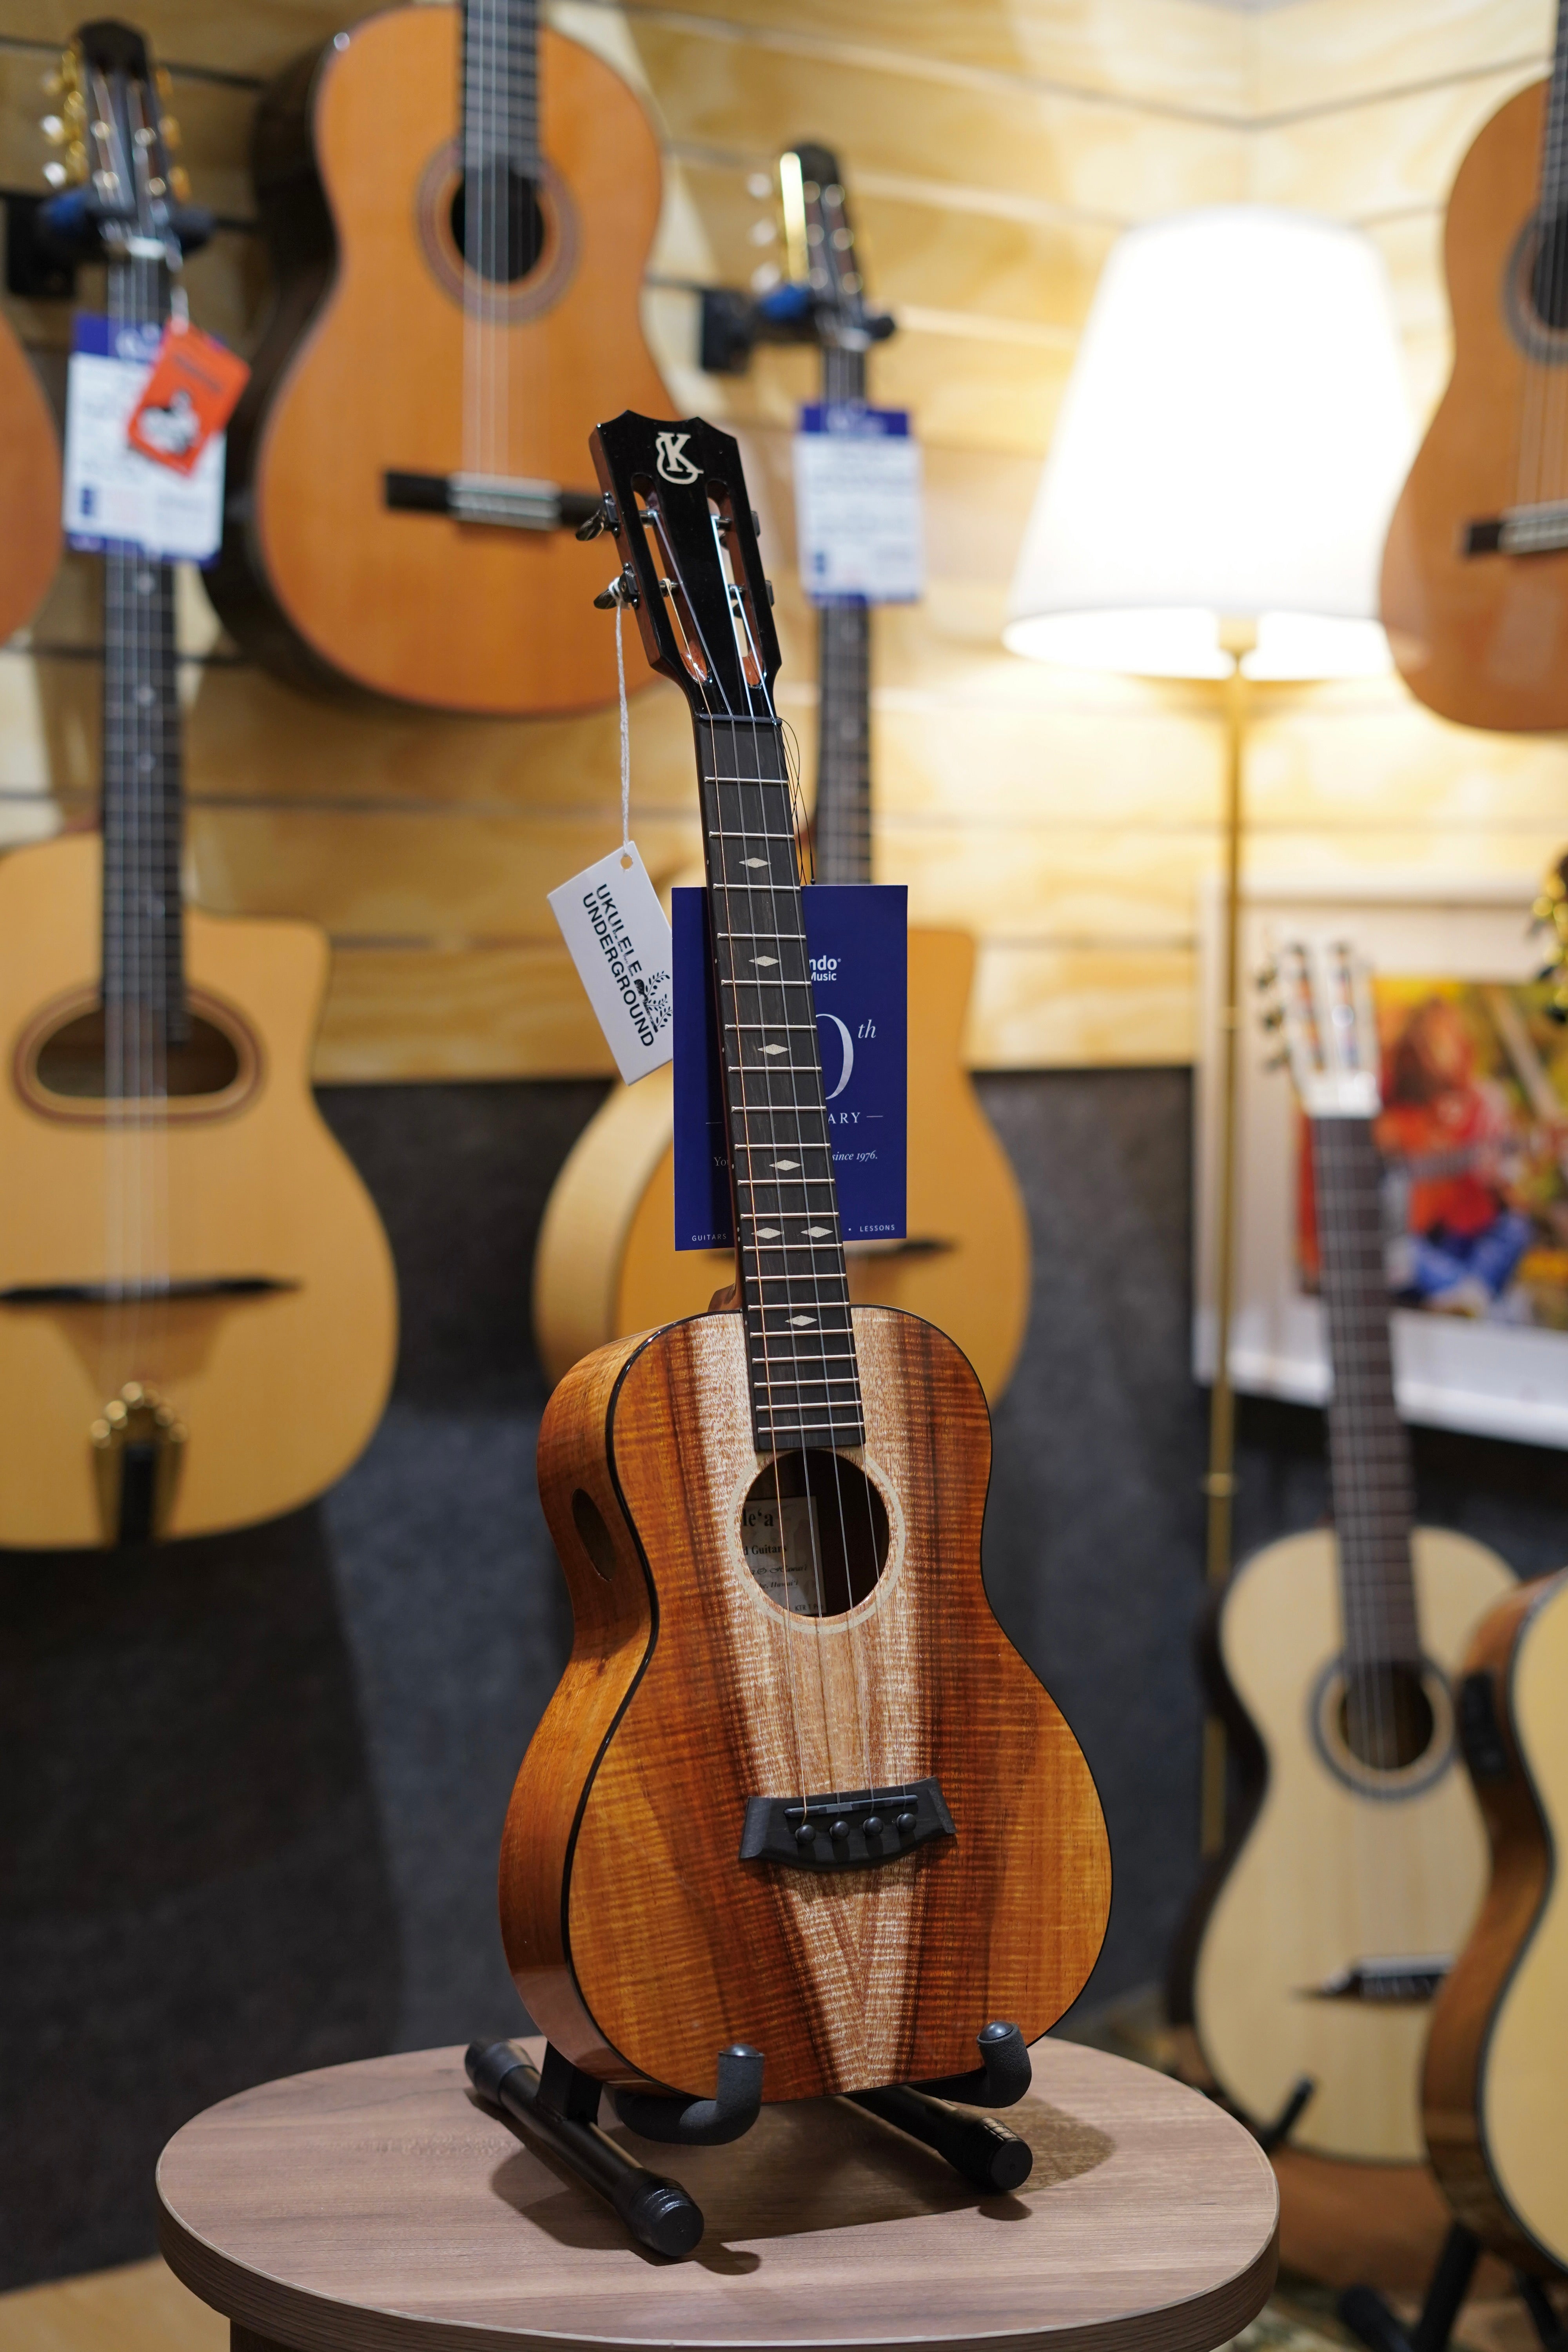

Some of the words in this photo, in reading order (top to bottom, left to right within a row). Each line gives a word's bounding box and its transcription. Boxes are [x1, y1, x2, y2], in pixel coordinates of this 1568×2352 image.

[596, 884, 642, 976] UKULELE
[583, 892, 654, 1046] UNDERGROUND
[828, 1112, 860, 1124] ARY
[832, 1151, 854, 1160] since
[856, 1150, 878, 1162] 1976.
[751, 1544, 787, 1555] Guitars
